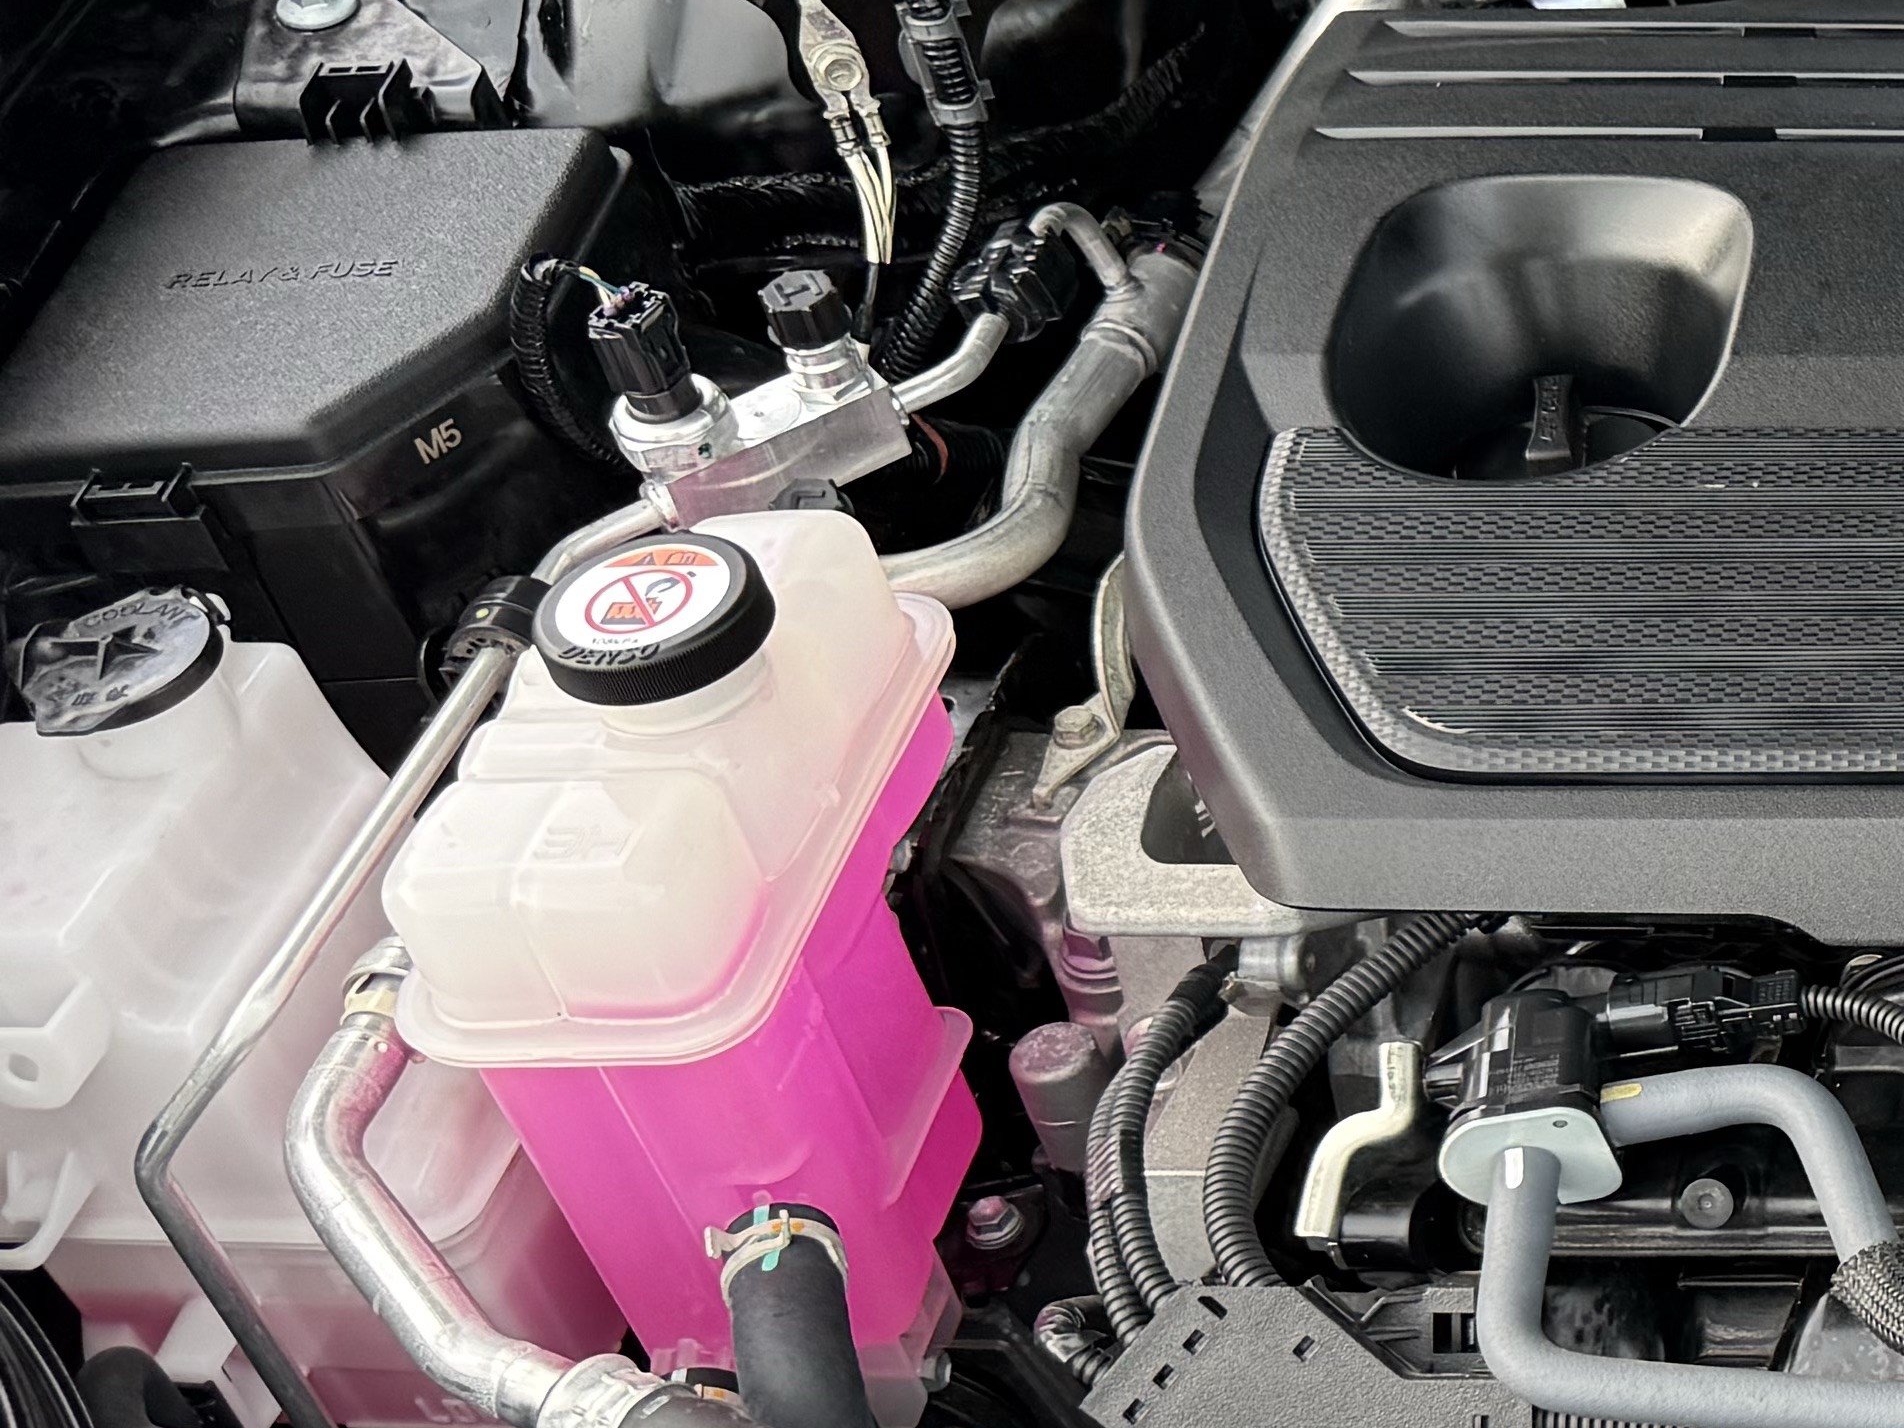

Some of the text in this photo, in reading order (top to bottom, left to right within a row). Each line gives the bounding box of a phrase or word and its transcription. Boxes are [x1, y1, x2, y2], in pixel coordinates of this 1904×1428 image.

[164, 267, 279, 289] RELAY
[310, 260, 399, 279] FUSE
[414, 418, 462, 465] M5
[83, 601, 202, 630] COOLANT
